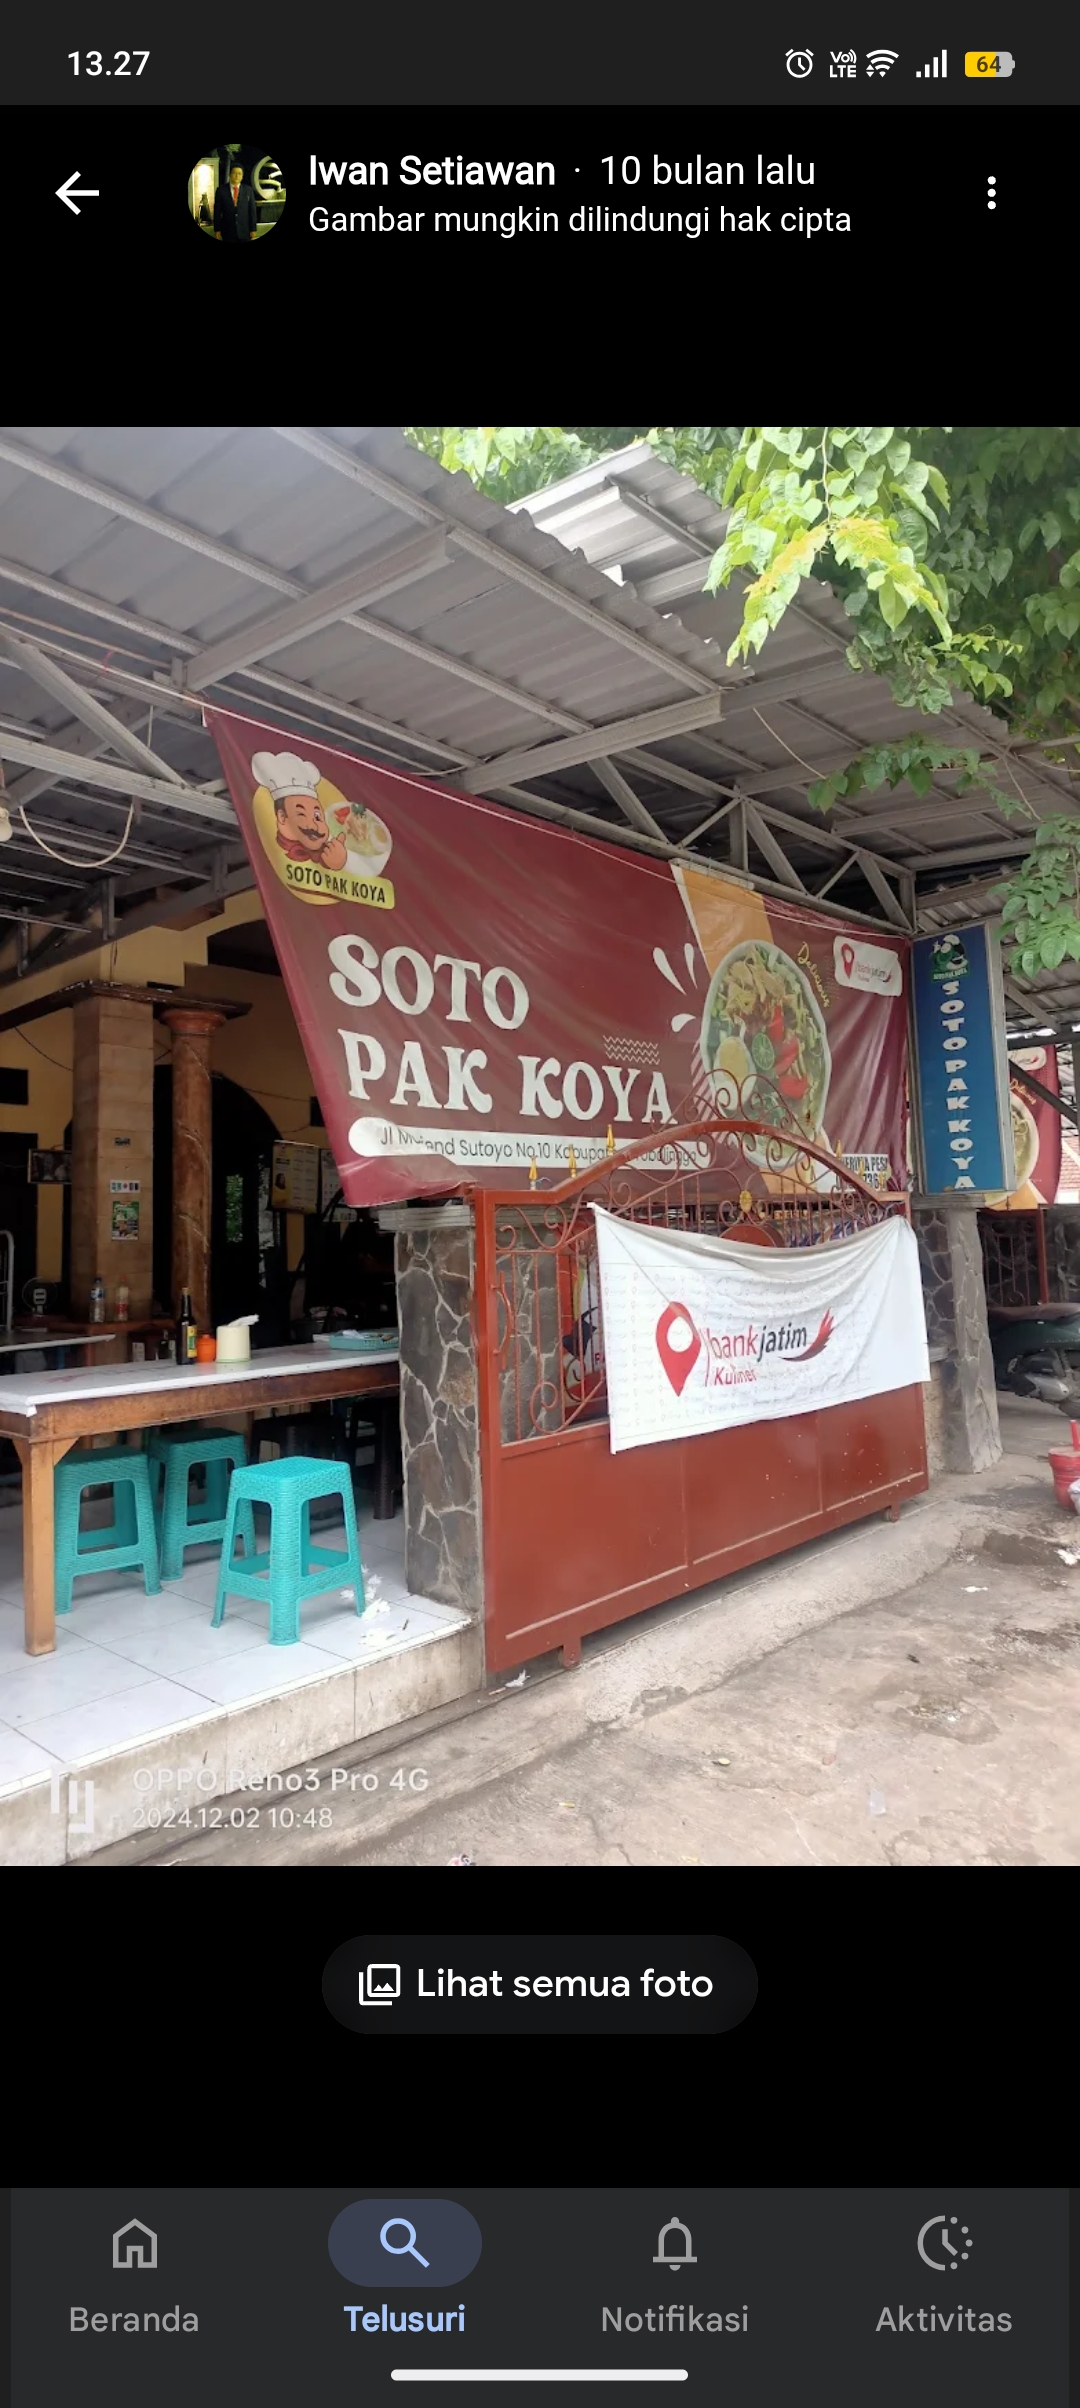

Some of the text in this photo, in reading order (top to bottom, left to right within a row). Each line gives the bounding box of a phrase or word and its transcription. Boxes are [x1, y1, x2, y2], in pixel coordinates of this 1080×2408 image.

[285, 864, 386, 903] SOTO PAK KOYA
[327, 933, 531, 1031] SOTO
[940, 981, 968, 1051] SOTO
[336, 1027, 679, 1126] PAK KOYA
[944, 1059, 970, 1111] PAK
[459, 1139, 512, 1163] Sutoyo
[516, 1142, 551, 1160] No.10
[946, 1118, 976, 1190] KOYA
